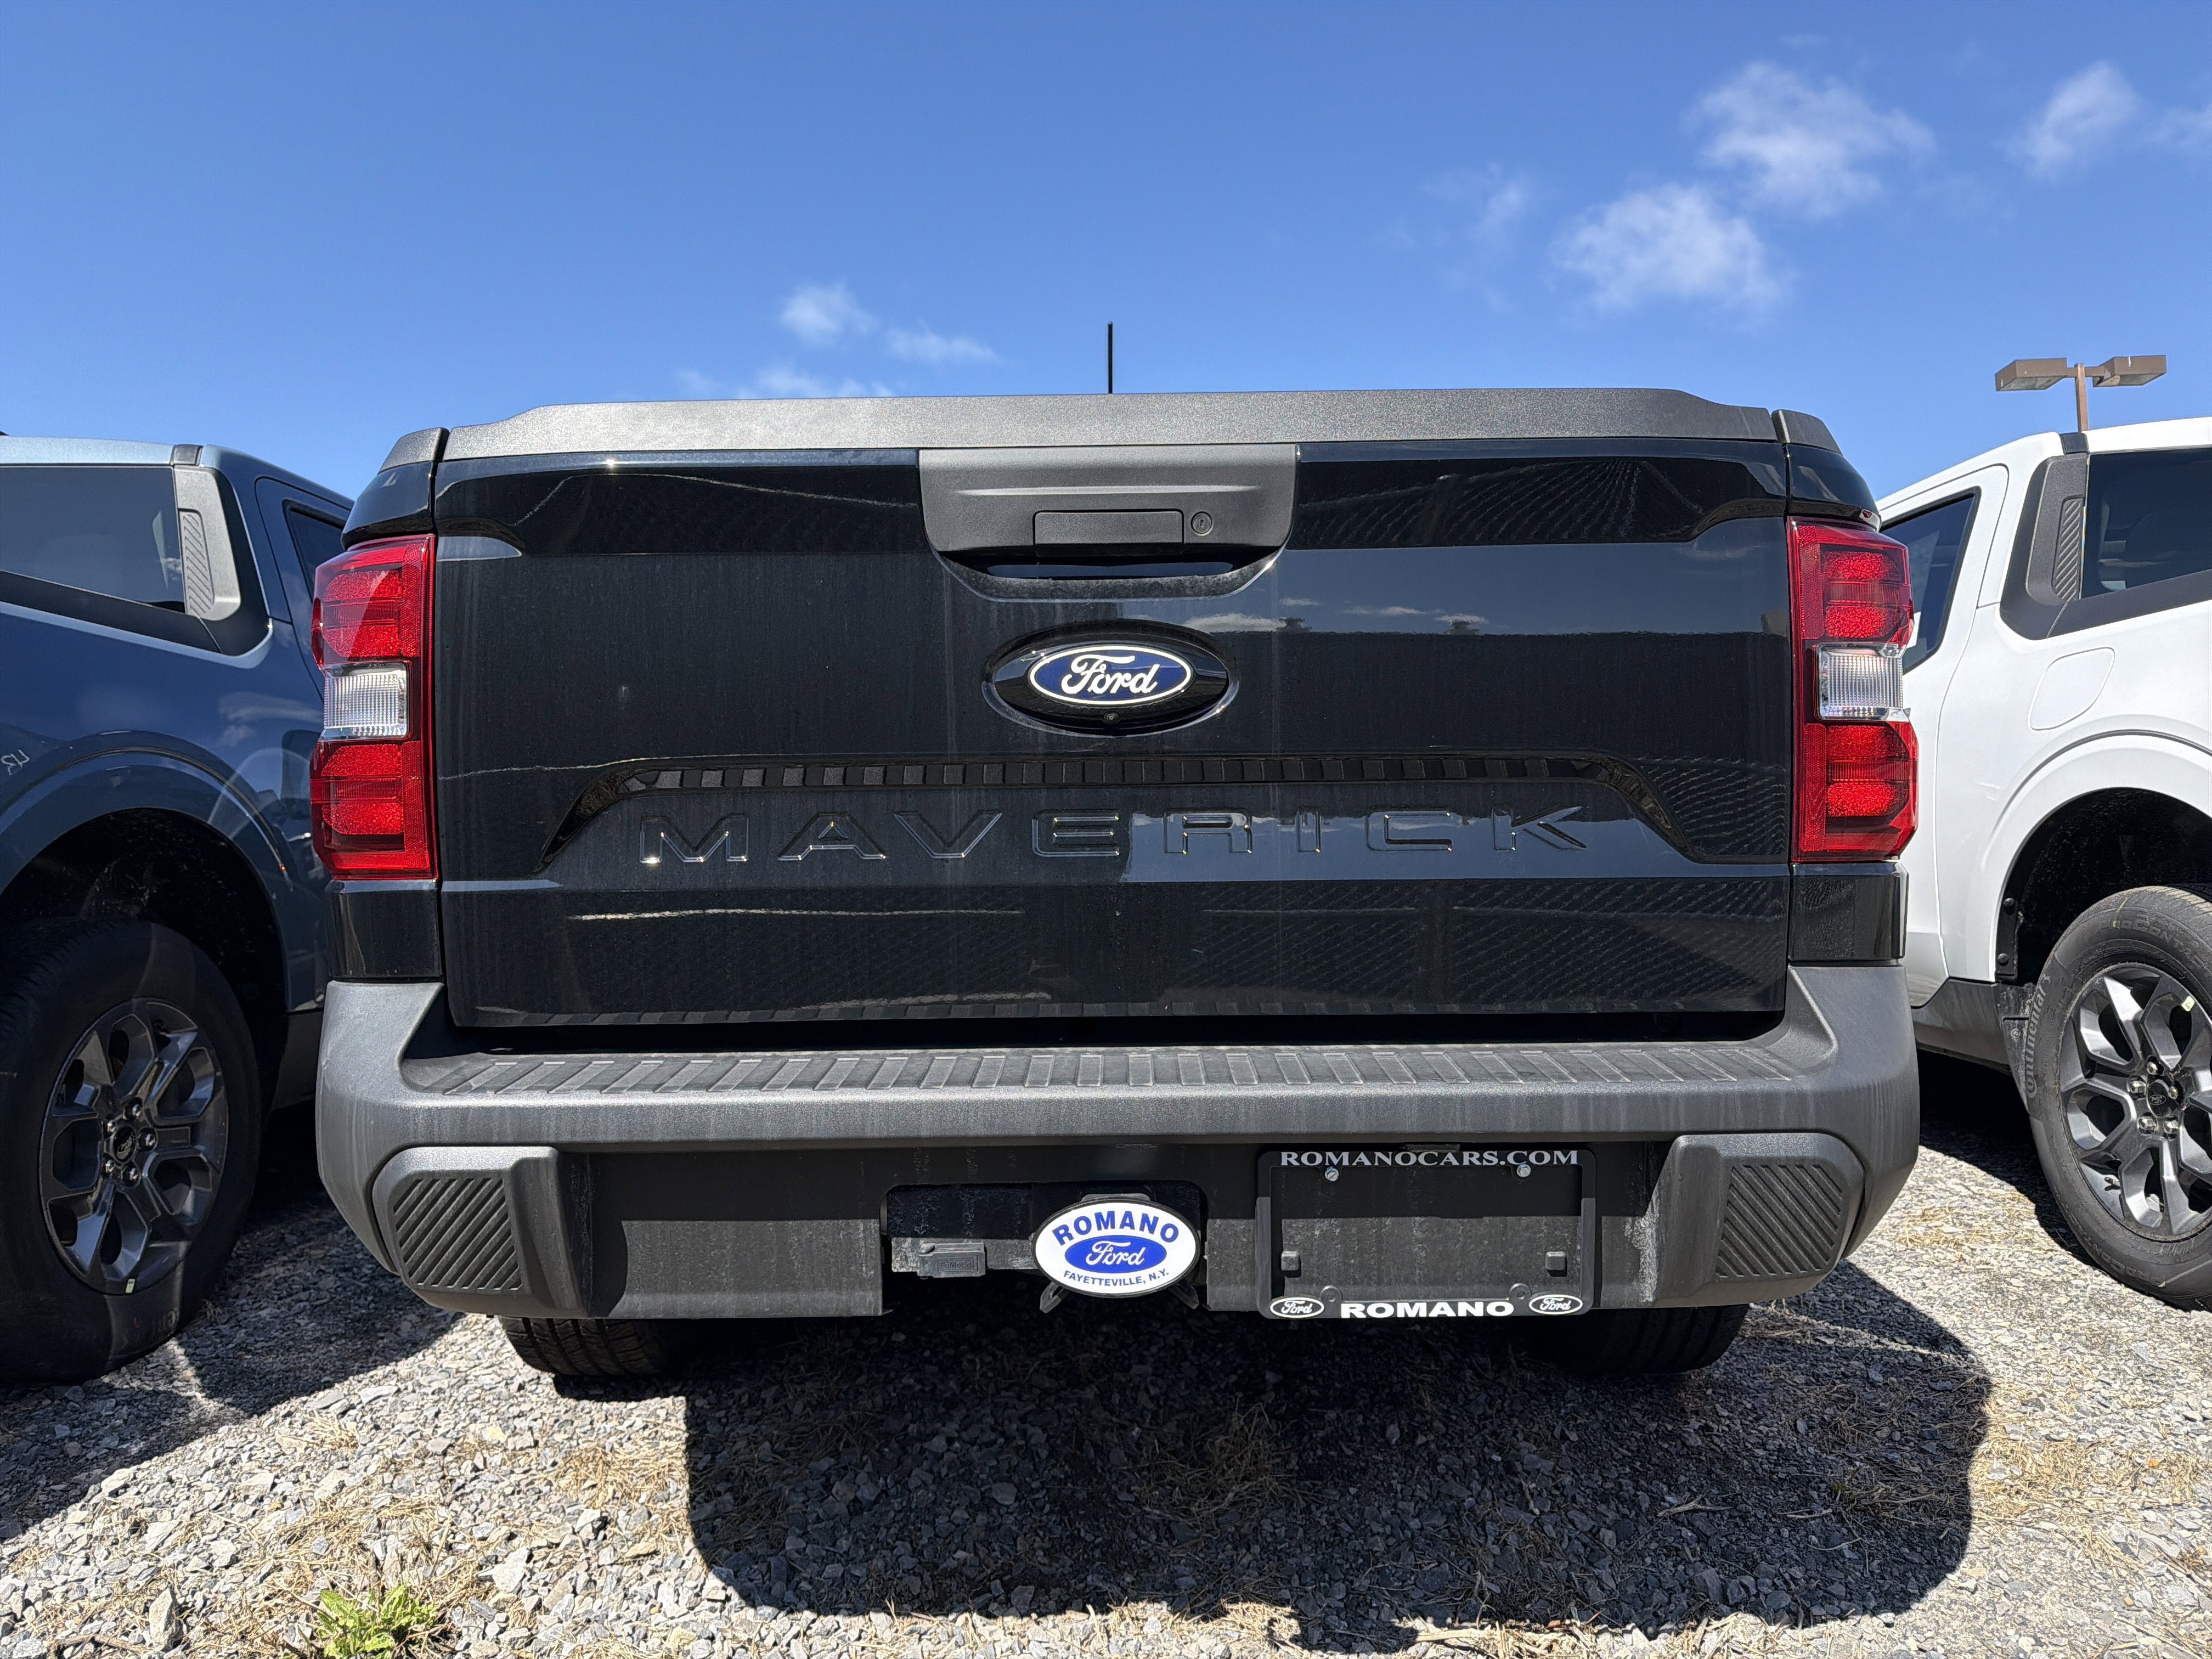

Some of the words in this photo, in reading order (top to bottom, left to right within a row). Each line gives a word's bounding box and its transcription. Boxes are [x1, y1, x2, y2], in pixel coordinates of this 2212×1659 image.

[1061, 654, 1160, 694] Ford
[639, 805, 1587, 864] MAVERICK
[1280, 1150, 1578, 1166] ROMANOCARS.COM
[1052, 1210, 1179, 1246] ROMANO
[1086, 1240, 1146, 1266] Ford
[1063, 1270, 1146, 1286] FAYETTEVILLE,
[1149, 1268, 1169, 1281] N.Y.
[1281, 1300, 1313, 1314] Ford
[1340, 1301, 1514, 1318] ROMANO
[1539, 1296, 1571, 1311] Ford
